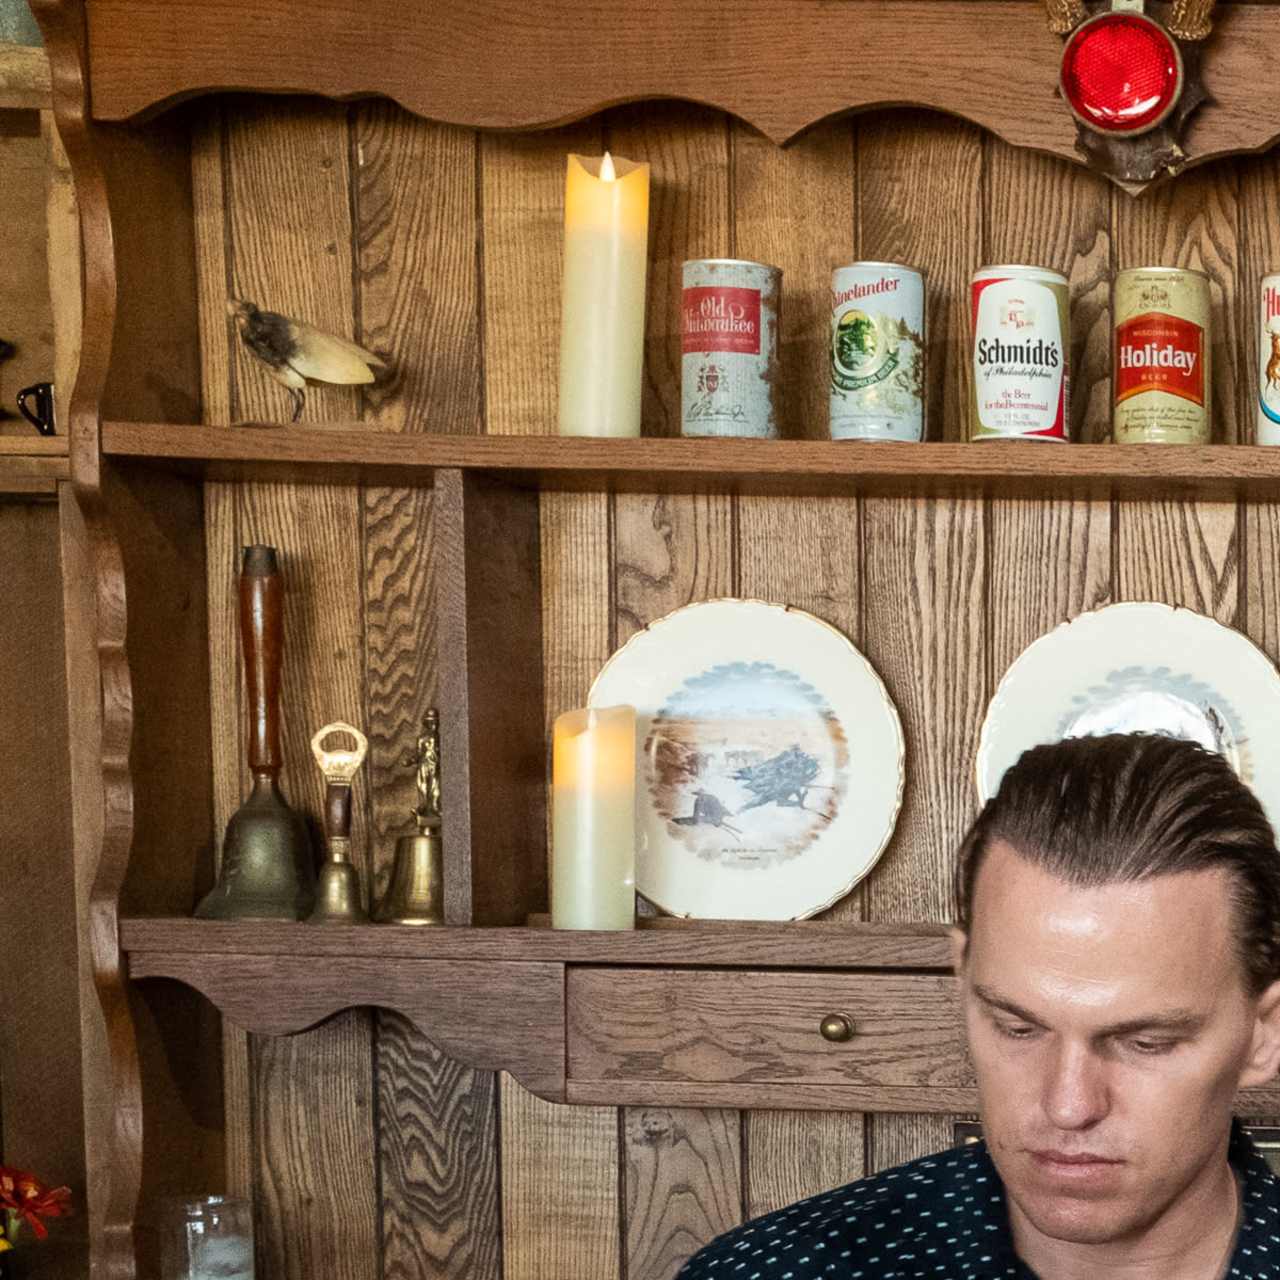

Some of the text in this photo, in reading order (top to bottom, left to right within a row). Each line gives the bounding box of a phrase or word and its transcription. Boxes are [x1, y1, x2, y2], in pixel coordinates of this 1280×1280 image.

[700, 296, 725, 319] Old
[978, 337, 1059, 368] Schmidt's
[1120, 342, 1197, 376] Holiday
[1141, 373, 1168, 381] BEER
